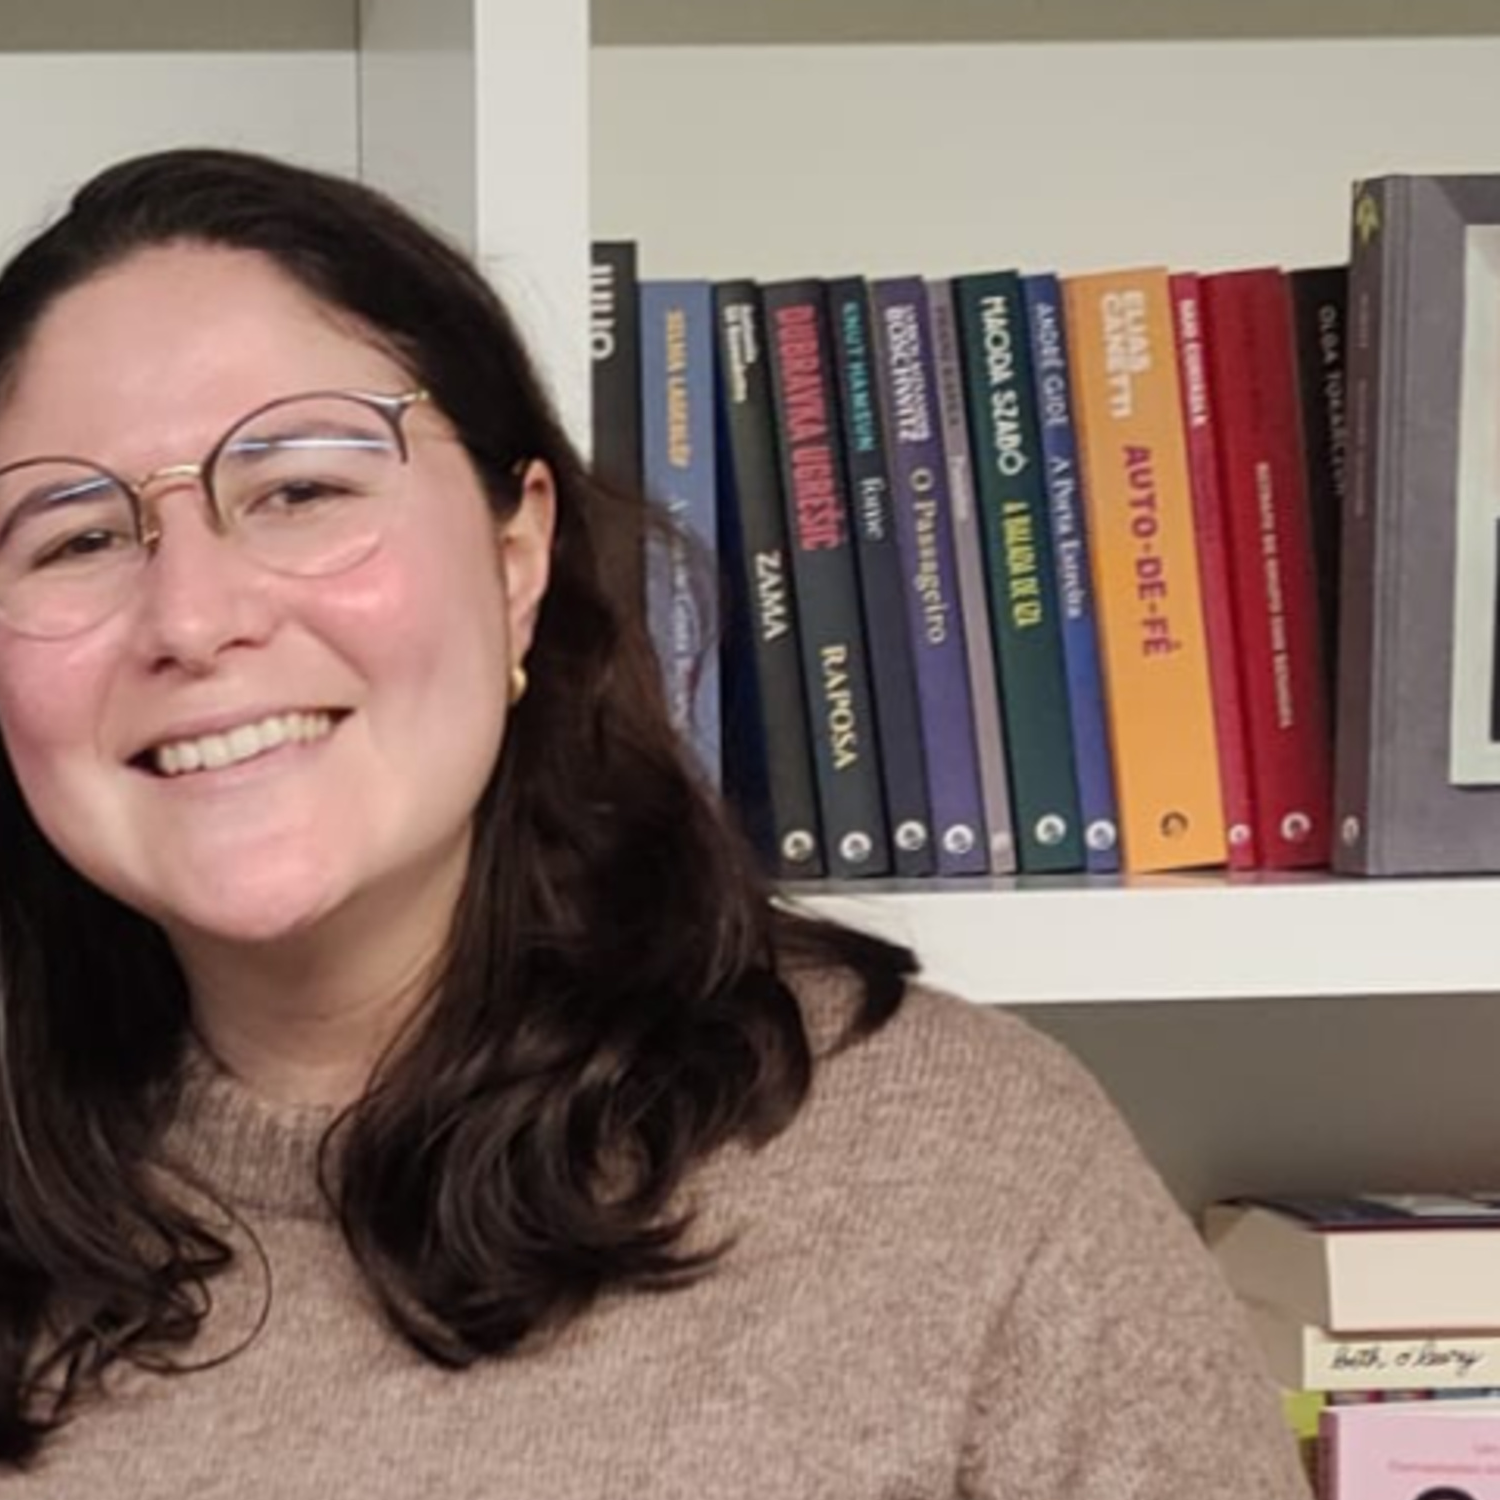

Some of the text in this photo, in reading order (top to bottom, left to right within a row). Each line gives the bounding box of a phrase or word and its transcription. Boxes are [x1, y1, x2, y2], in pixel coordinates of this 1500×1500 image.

[774, 303, 829, 448] DUBRAVKA
[755, 550, 789, 642] ZAMA
[909, 468, 950, 644] O Passageiro
[1121, 444, 1183, 657] AUTO-DE-FÉ
[821, 644, 858, 771] RAPOSA
